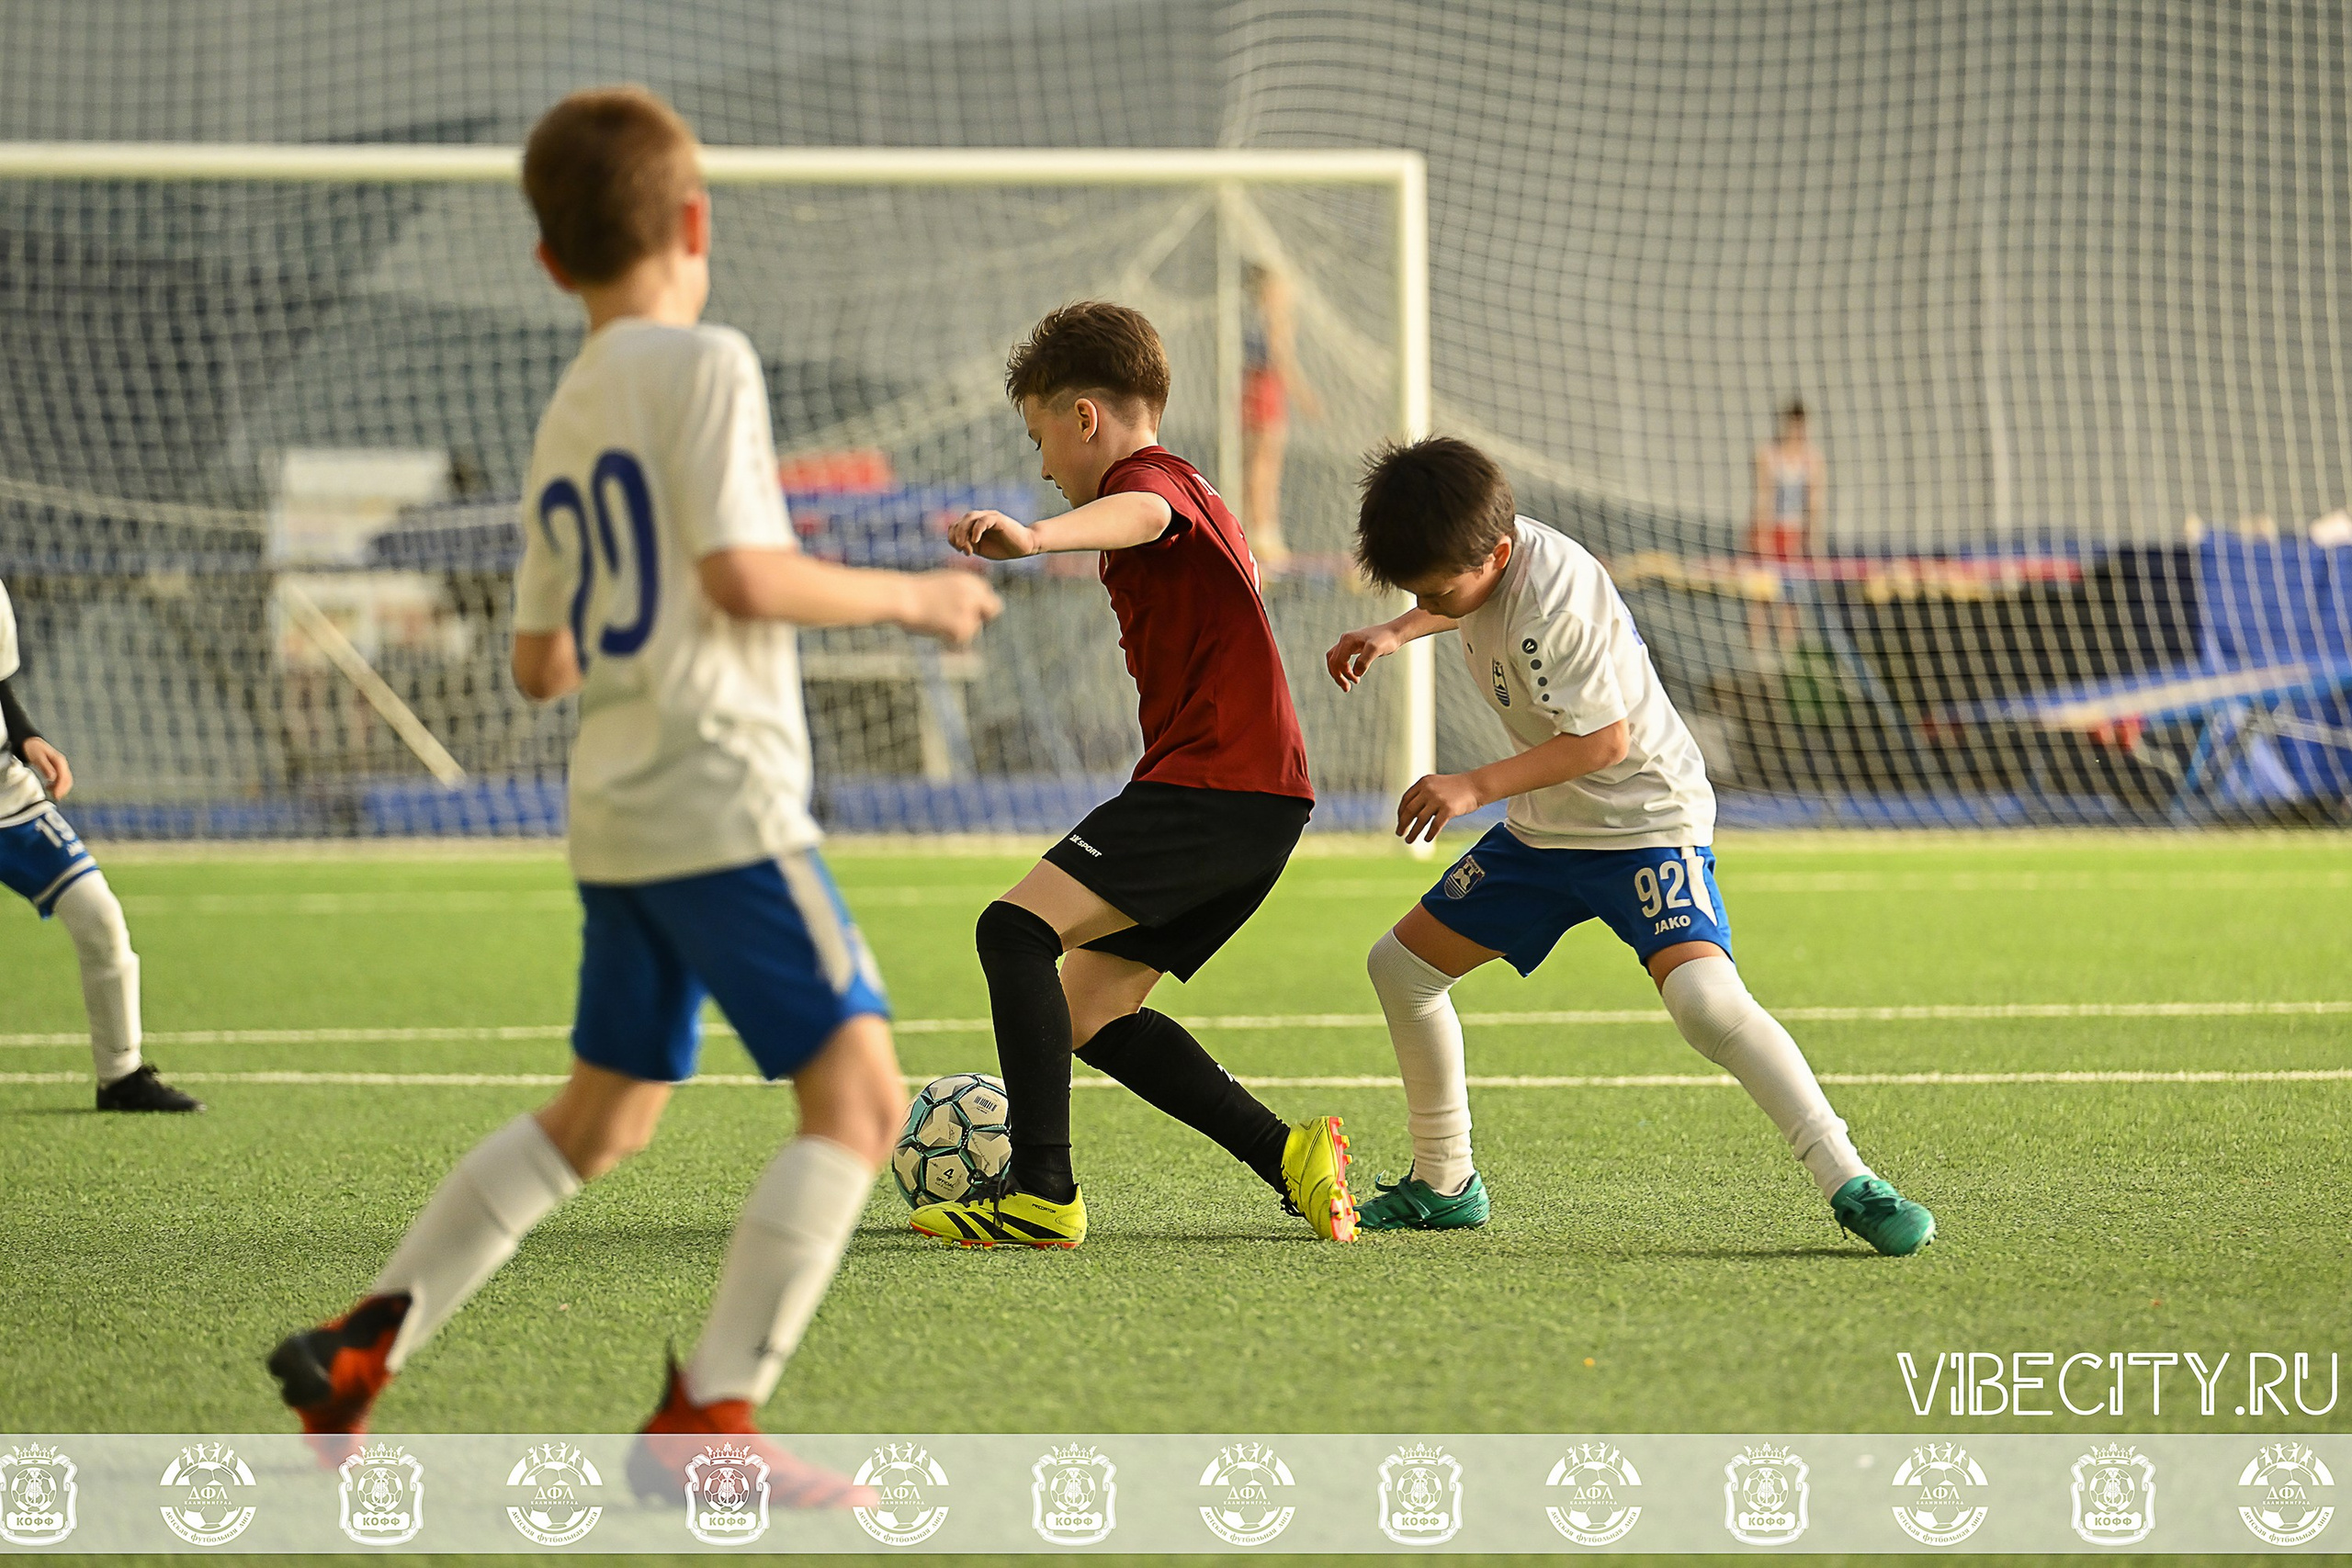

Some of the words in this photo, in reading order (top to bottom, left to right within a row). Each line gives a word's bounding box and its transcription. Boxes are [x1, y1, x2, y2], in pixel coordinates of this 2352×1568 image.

[1634, 860, 1692, 918] 92
[1654, 914, 1691, 935] JAKO
[943, 1168, 955, 1179] 4
[1031, 1202, 1057, 1214] PREDATOR
